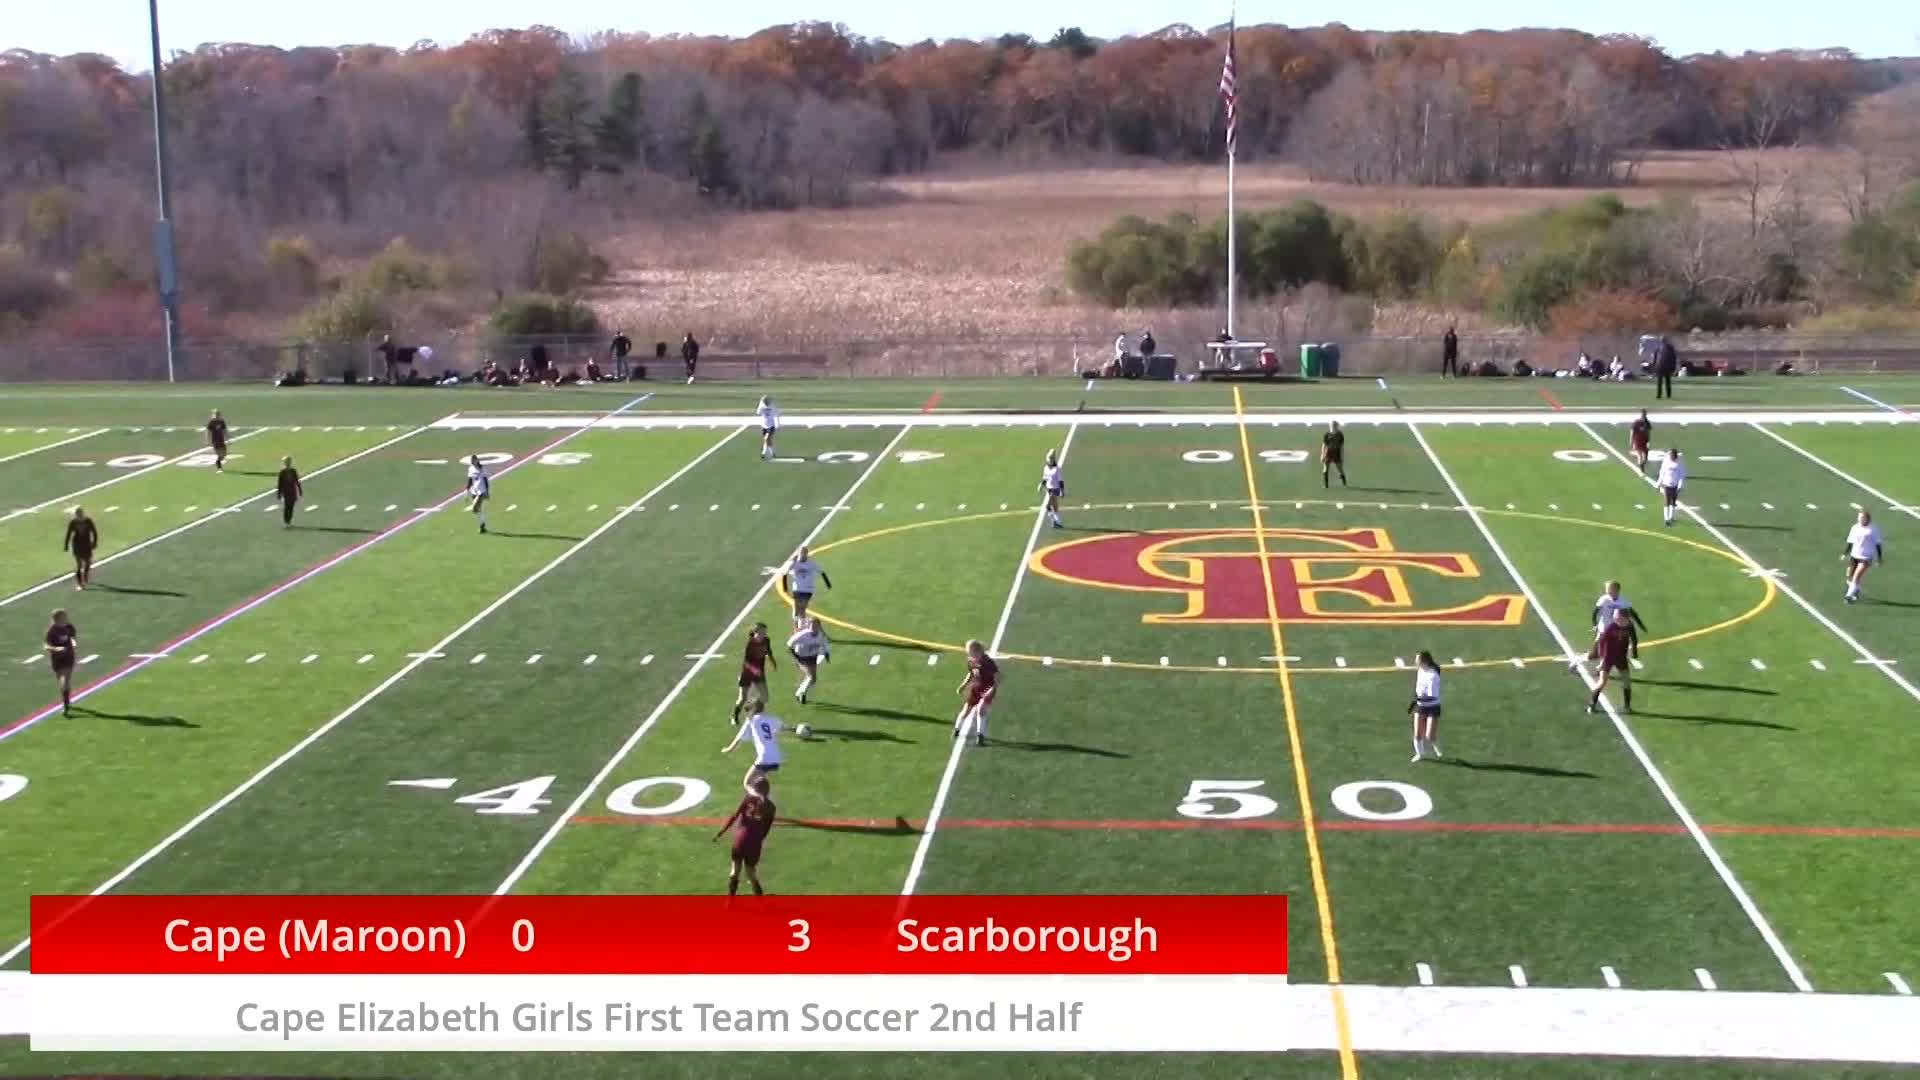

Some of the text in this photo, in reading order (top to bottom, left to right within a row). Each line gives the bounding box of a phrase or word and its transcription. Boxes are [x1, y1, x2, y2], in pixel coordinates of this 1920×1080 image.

[1183, 450, 1308, 463] 50
[761, 722, 772, 740] 9
[455, 775, 711, 815] 40
[1176, 779, 1433, 820] 50
